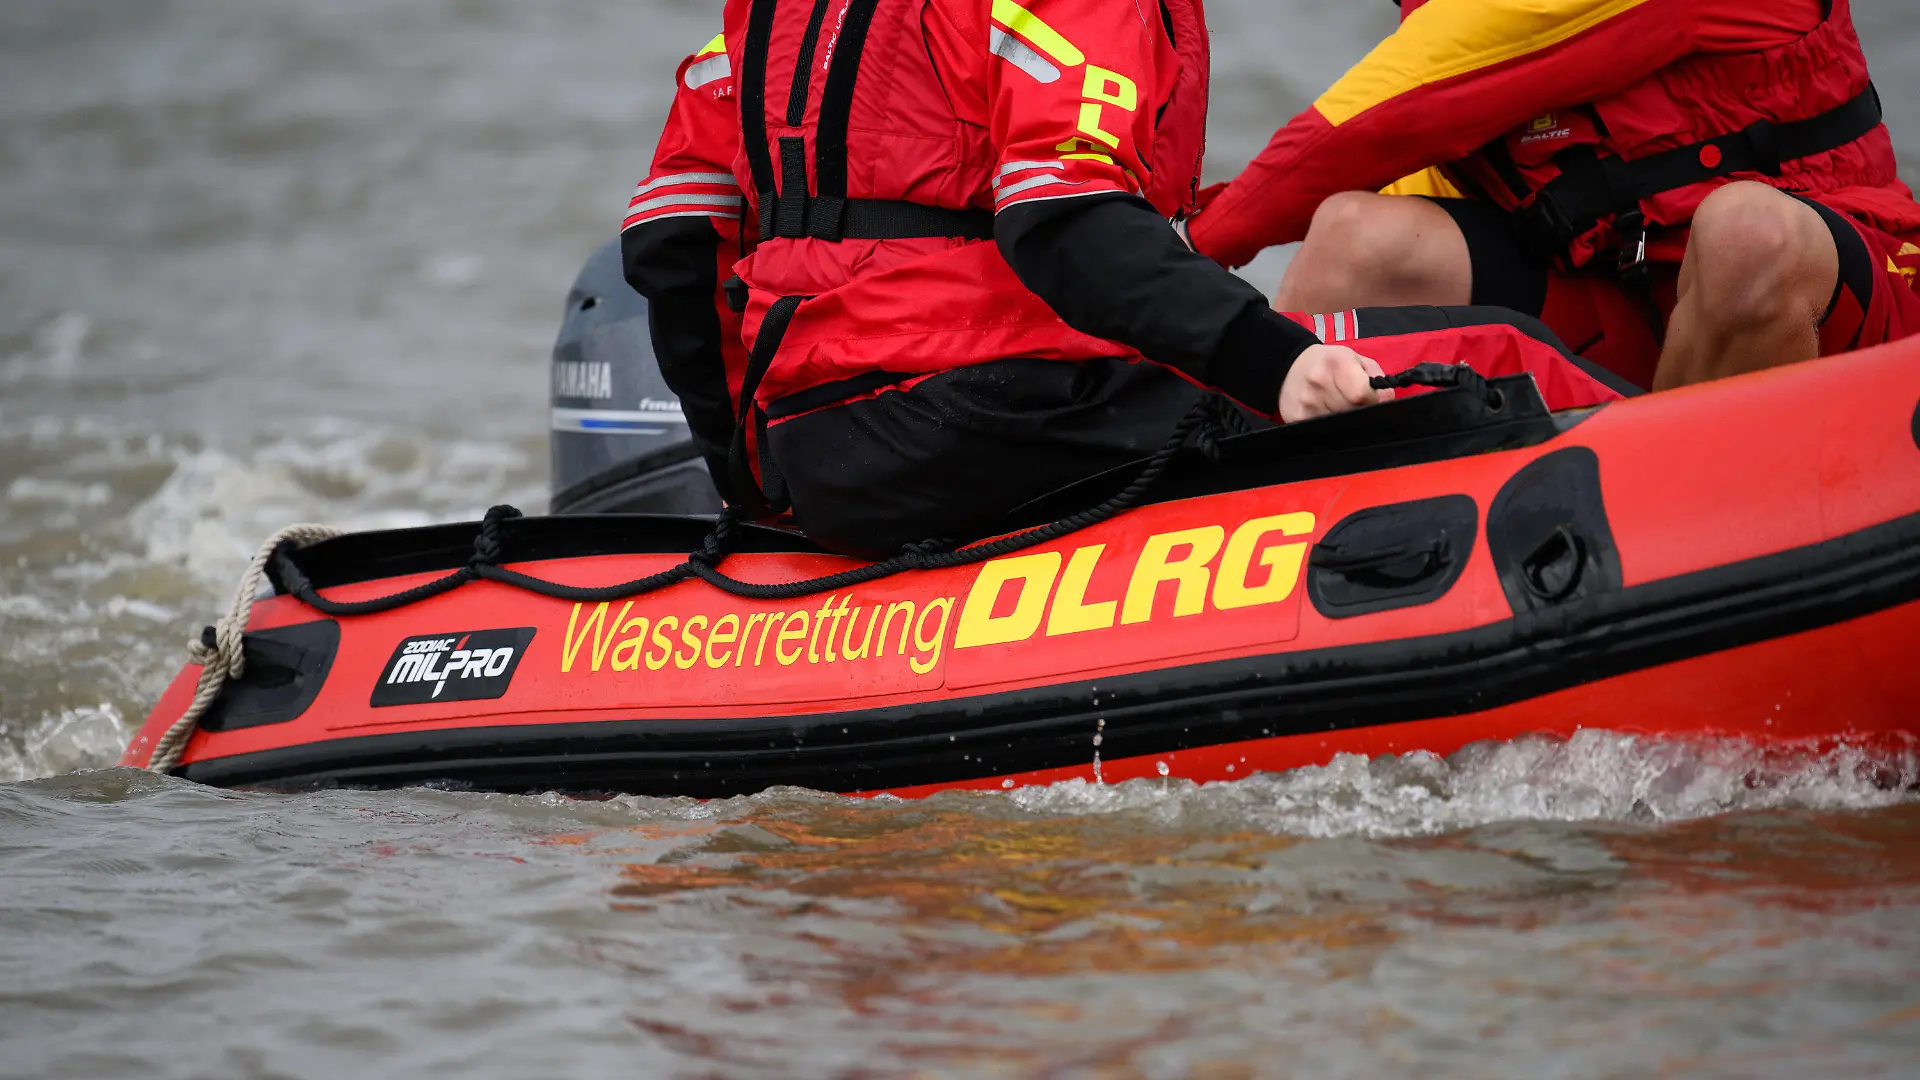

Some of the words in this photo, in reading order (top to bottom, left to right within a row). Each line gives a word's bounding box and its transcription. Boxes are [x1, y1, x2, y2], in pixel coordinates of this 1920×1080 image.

[823, 32, 837, 70] BALTIC
[561, 593, 956, 674] Wasserrettung
[954, 511, 1316, 649] DLRG
[402, 638, 456, 654] ZODIAC
[387, 647, 514, 699] MILPRO
